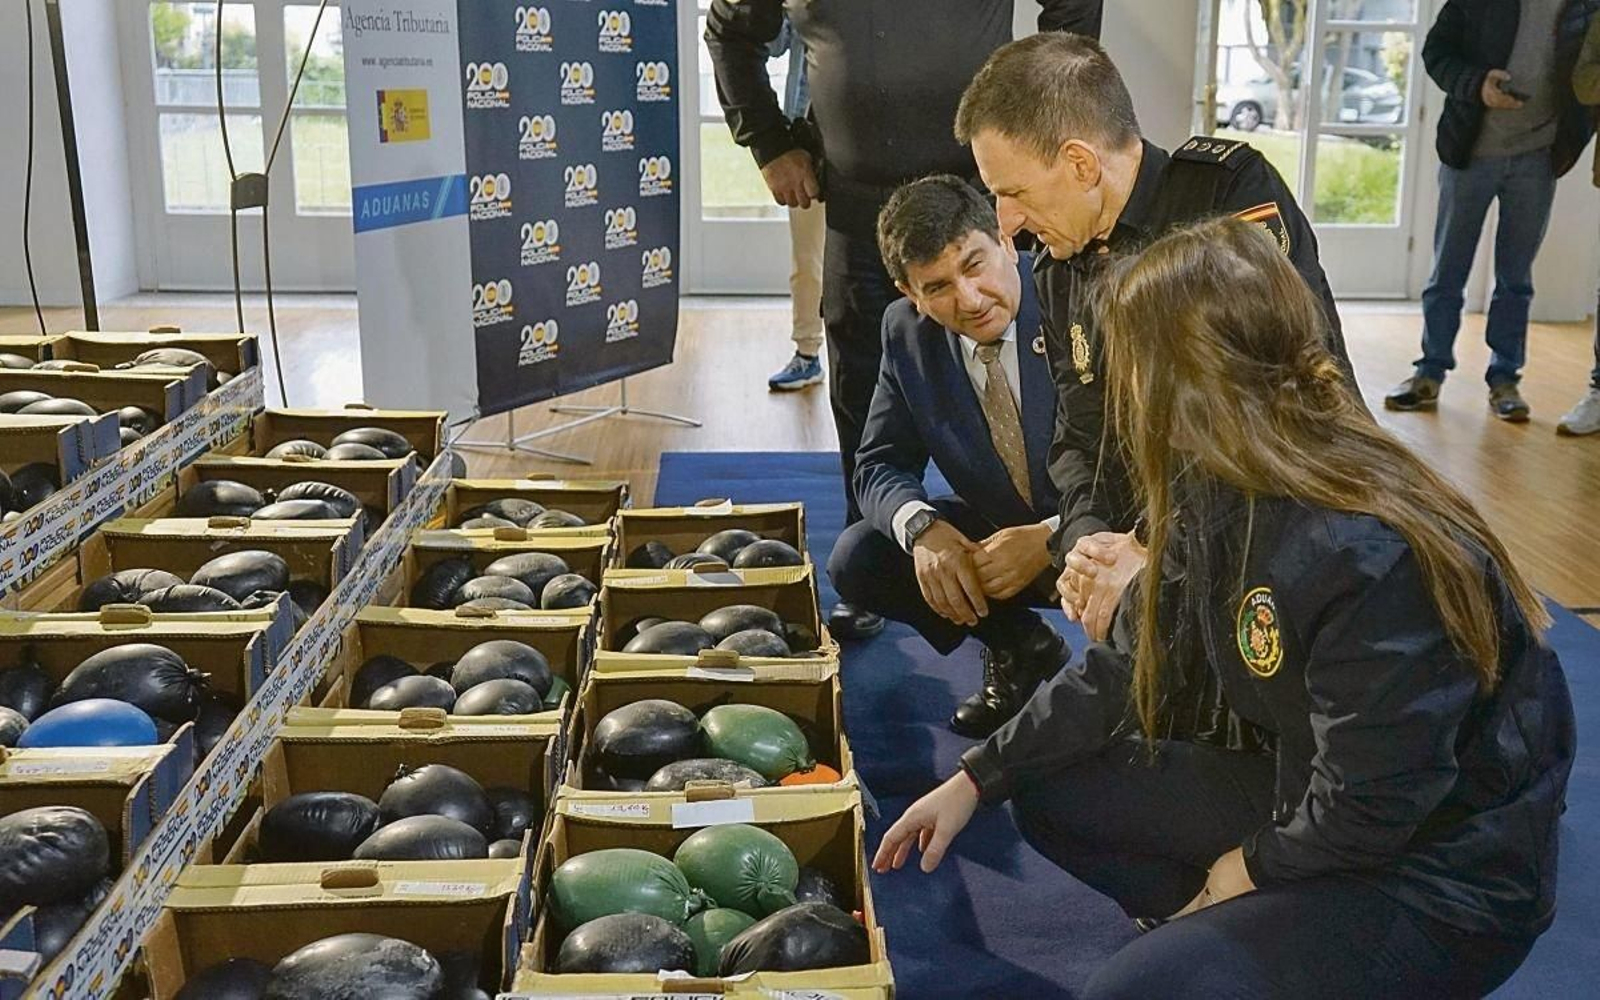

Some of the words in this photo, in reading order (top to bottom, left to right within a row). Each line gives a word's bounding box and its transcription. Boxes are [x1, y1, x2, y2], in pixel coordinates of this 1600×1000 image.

[345, 6, 392, 37] Agencia
[393, 10, 449, 33] Tributaria
[515, 6, 551, 35] 200
[598, 10, 631, 36] 200
[466, 62, 508, 91] 200
[560, 62, 594, 88] 200
[636, 61, 669, 86] 200
[519, 114, 556, 142] 200
[601, 110, 634, 136] 200
[564, 163, 597, 192] 200
[639, 155, 671, 182] 200
[470, 173, 511, 203] 200
[361, 191, 430, 219] ADUANAS
[520, 219, 559, 250] 200
[605, 206, 636, 234] 200
[642, 246, 672, 274] 200
[566, 261, 600, 292] 200
[472, 279, 512, 311] 200
[607, 299, 638, 328] 200
[520, 319, 558, 351] 200
[19, 543, 39, 570] 200
[131, 854, 151, 901] 200
